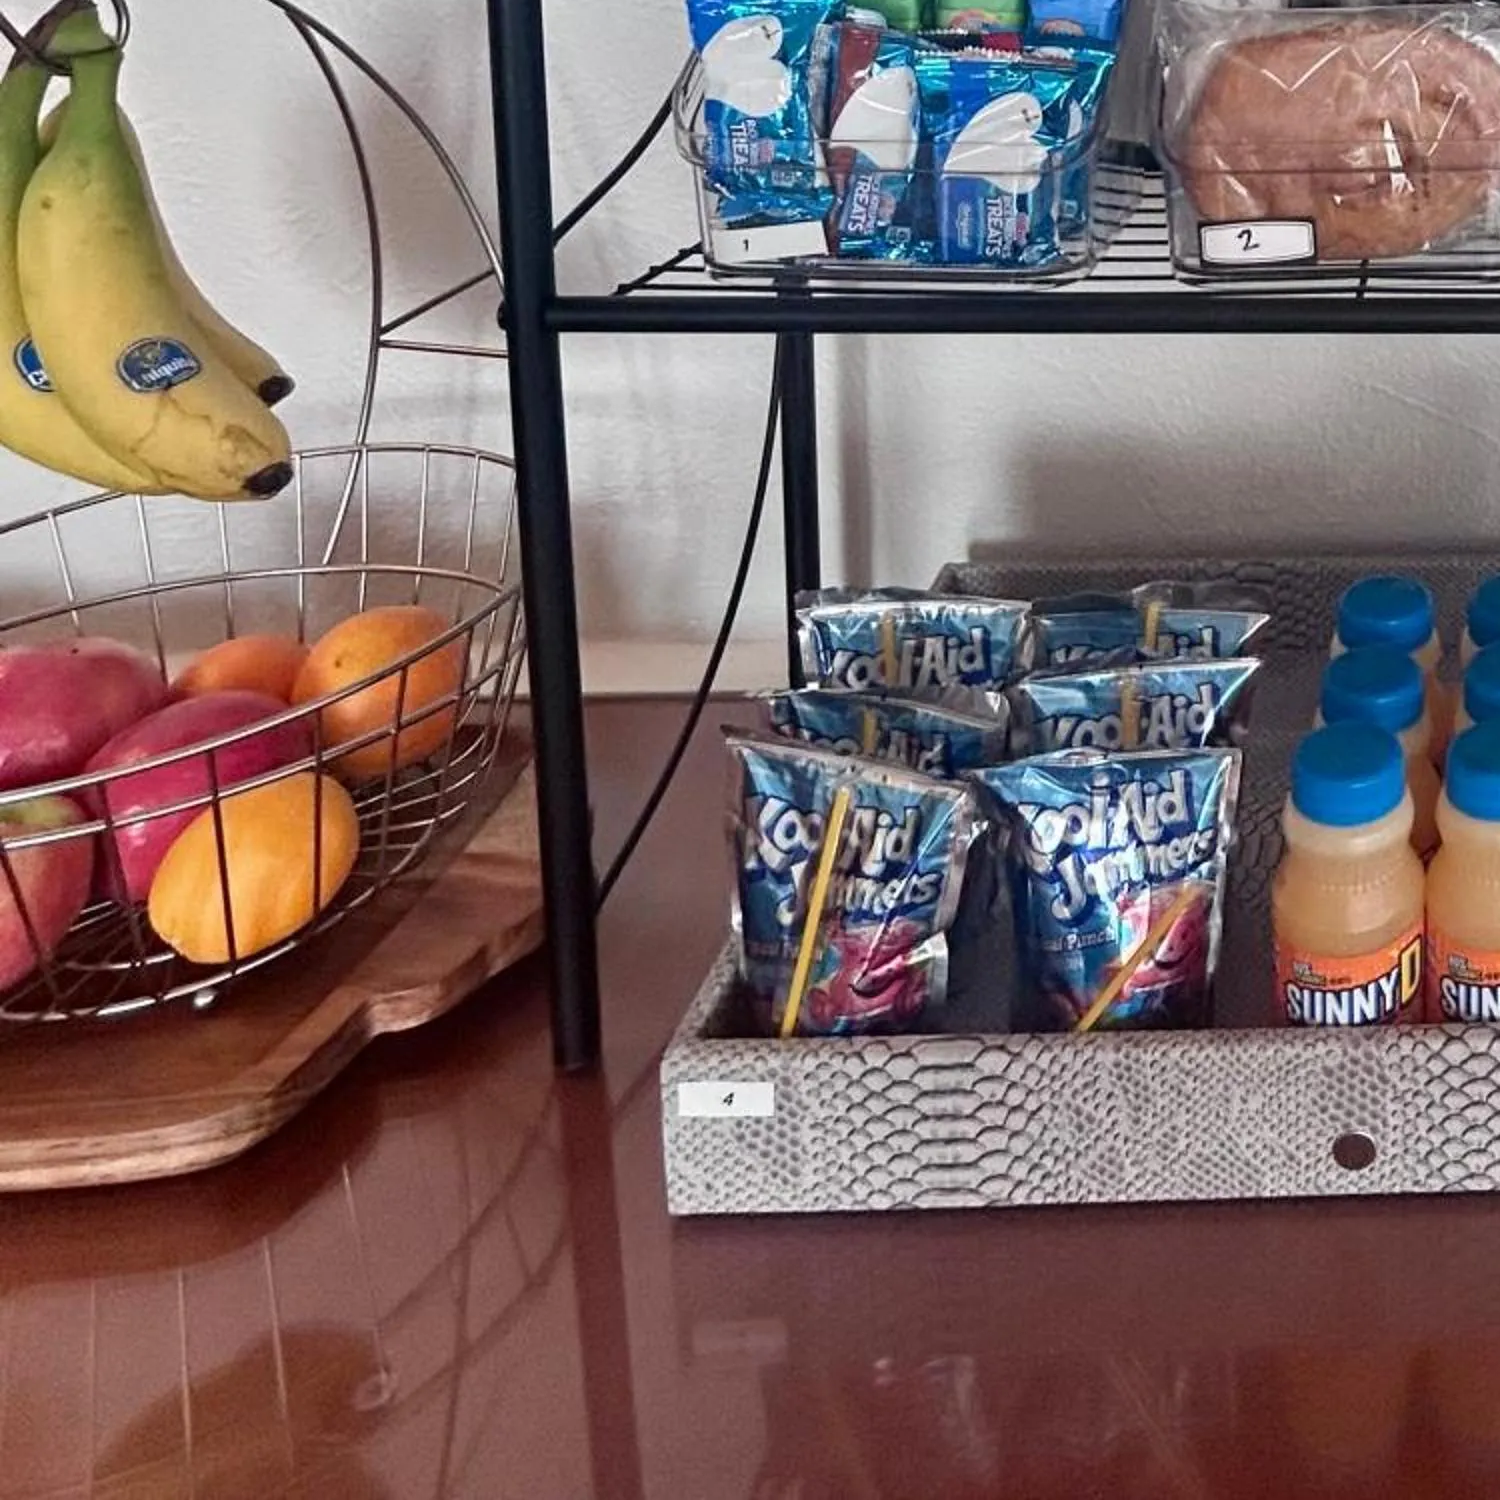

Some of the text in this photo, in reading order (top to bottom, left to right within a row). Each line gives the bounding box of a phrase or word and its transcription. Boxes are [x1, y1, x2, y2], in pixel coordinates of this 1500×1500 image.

[985, 198, 1001, 258] TREATS
[743, 238, 749, 252] 1
[1237, 228, 1260, 251] 2
[723, 1092, 735, 1106] 4
